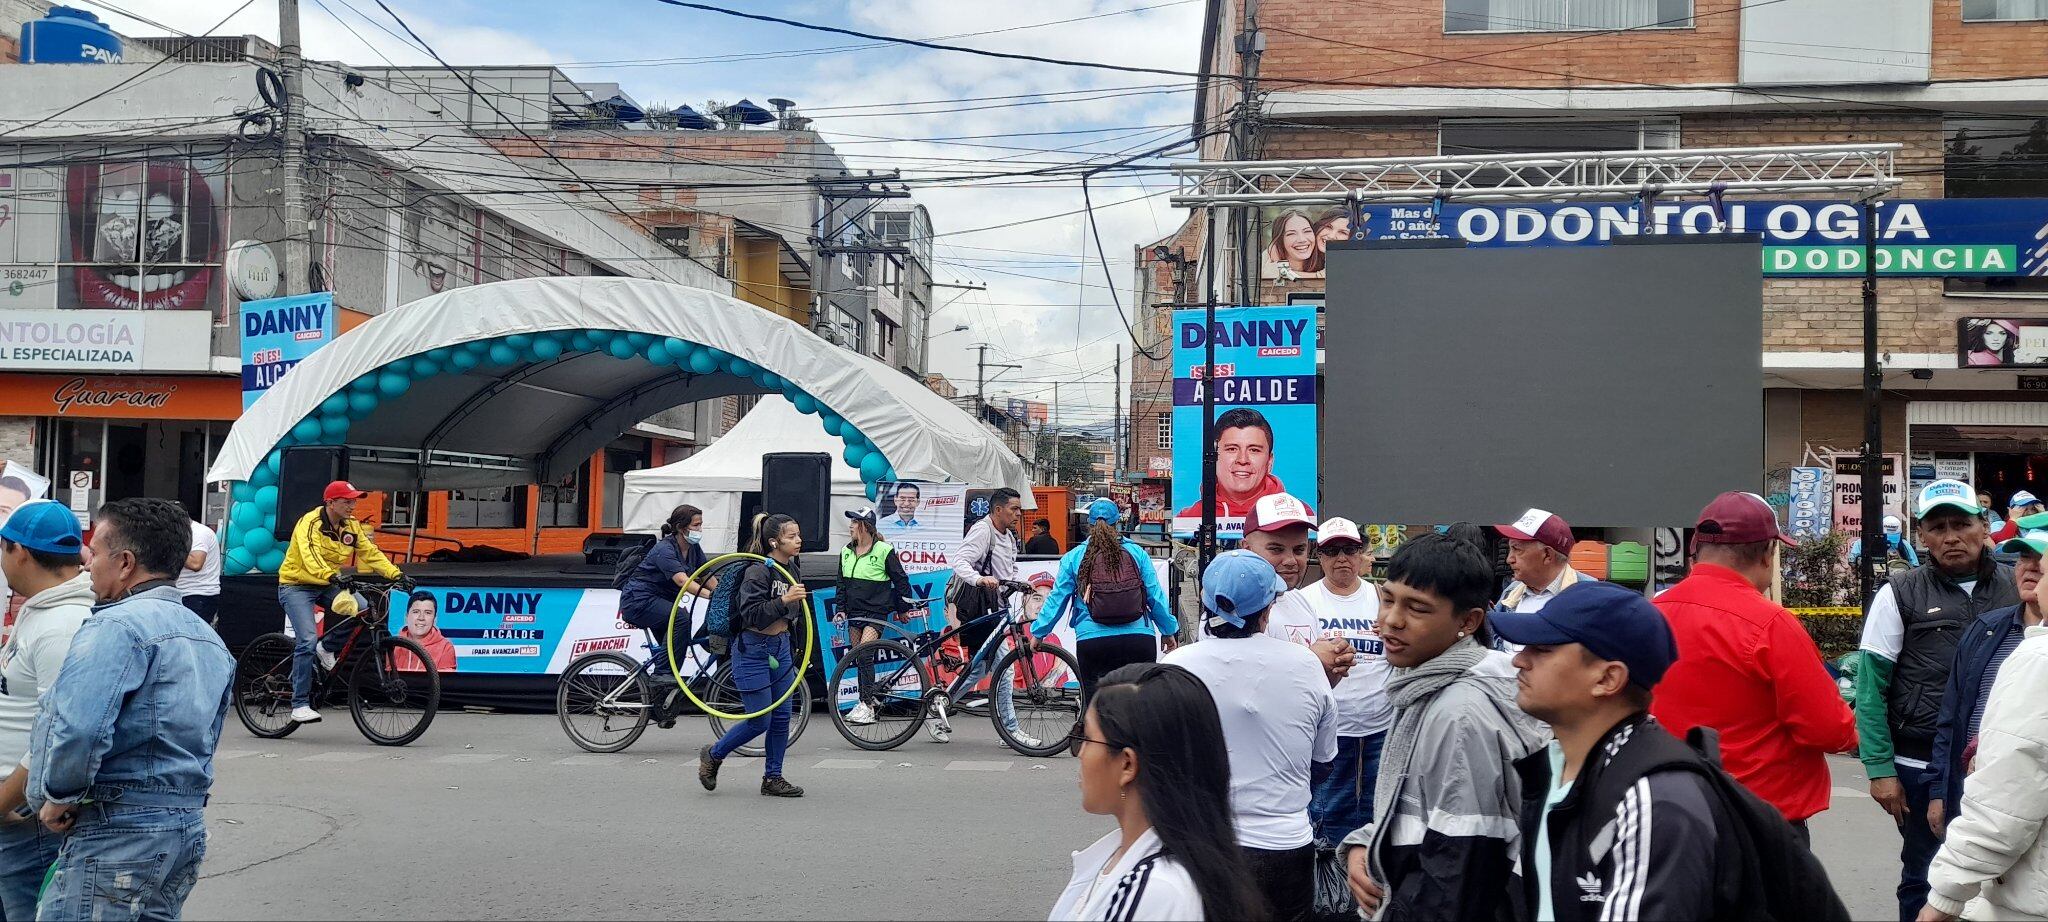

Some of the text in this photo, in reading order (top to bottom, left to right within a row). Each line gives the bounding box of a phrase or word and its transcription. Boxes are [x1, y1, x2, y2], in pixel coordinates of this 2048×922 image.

[1391, 207, 1432, 219] Mas d
[1390, 220, 1441, 231] 10 años
[1762, 248, 2006, 270] DODONCIA
[4, 269, 48, 279] 3682447
[245, 303, 328, 338] DANNY
[296, 331, 321, 341] CAICEDO
[1180, 318, 1309, 349] DANNY
[13, 347, 134, 363] ESPECIALIZADA
[267, 350, 281, 363] ES!
[1261, 348, 1298, 356] CAICEDO
[889, 541, 947, 550] ALFREDO
[896, 550, 948, 565] OLINA
[444, 591, 543, 615] DANNY
[482, 629, 536, 639] ALCALDE
[589, 637, 630, 652] MARCHA!
[840, 685, 861, 696] ¡PAR
